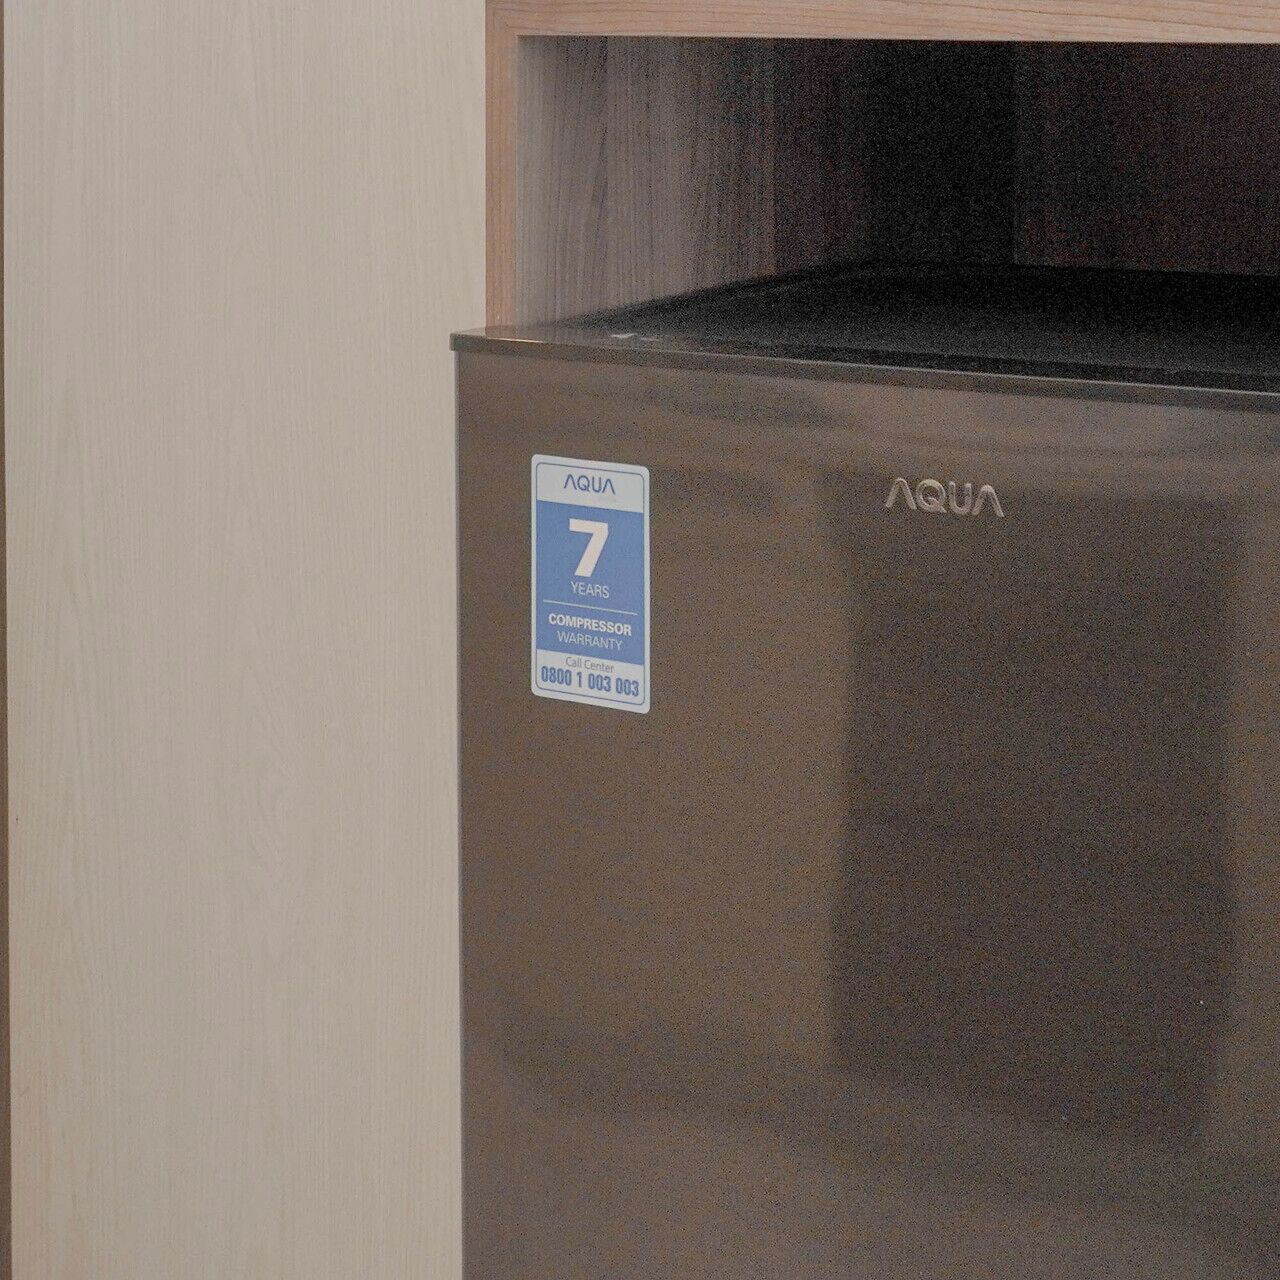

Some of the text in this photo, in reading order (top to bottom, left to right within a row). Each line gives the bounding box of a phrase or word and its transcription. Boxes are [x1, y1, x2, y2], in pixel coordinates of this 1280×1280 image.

[563, 473, 616, 495] AQUA
[885, 477, 1005, 518] AQUA
[569, 517, 609, 578] 7
[570, 580, 610, 599] YEARS
[548, 612, 632, 637] COMPRESSOR
[556, 630, 623, 651] WARRANTY
[565, 656, 614, 674] Call Center
[540, 665, 639, 698] 0800 1 003 003
